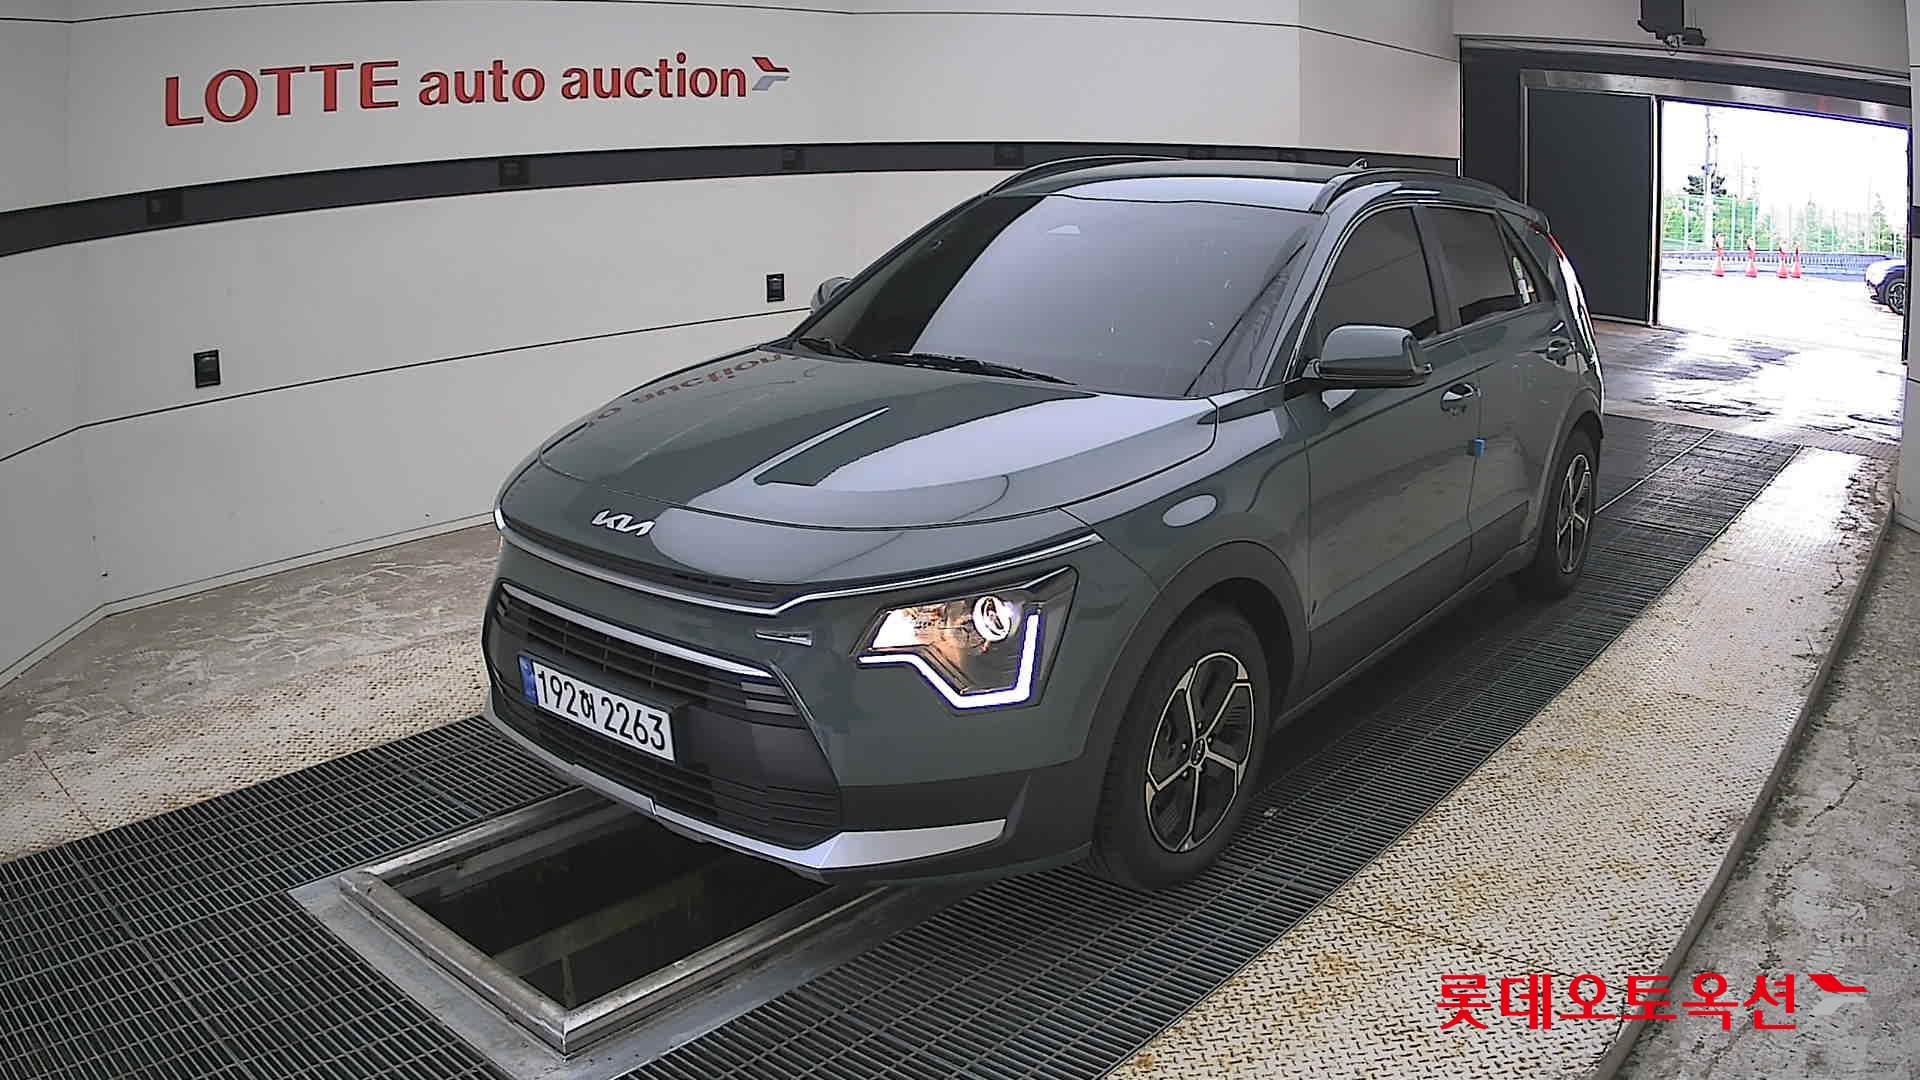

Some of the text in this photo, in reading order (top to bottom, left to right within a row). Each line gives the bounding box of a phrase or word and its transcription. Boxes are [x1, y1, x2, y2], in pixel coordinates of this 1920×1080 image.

[165, 53, 748, 127] LOTTE auto auction
[601, 697, 665, 751] 2263
